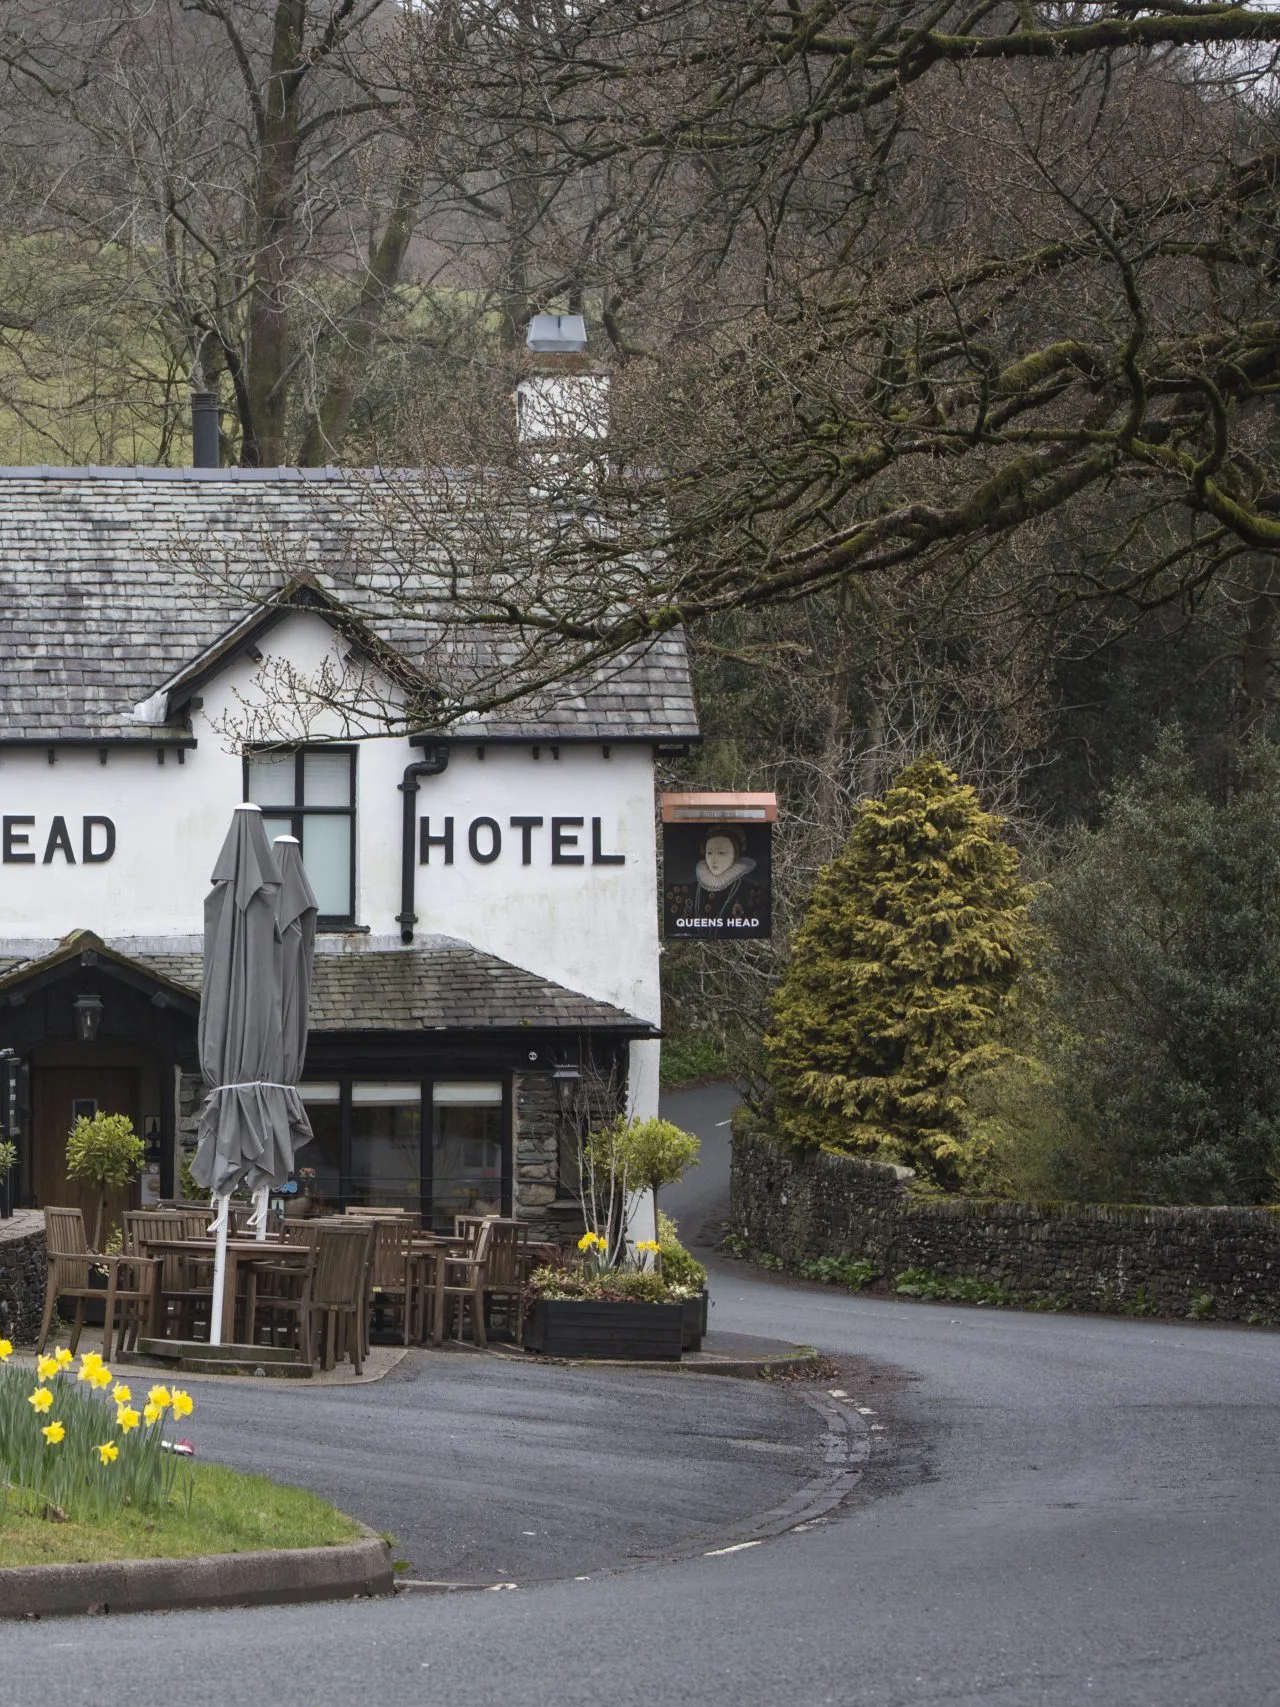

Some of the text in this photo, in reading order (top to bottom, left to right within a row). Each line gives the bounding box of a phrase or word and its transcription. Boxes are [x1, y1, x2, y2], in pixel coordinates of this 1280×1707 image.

[420, 816, 626, 866] HOTEL
[676, 918, 760, 928] QUEENS HEAD
